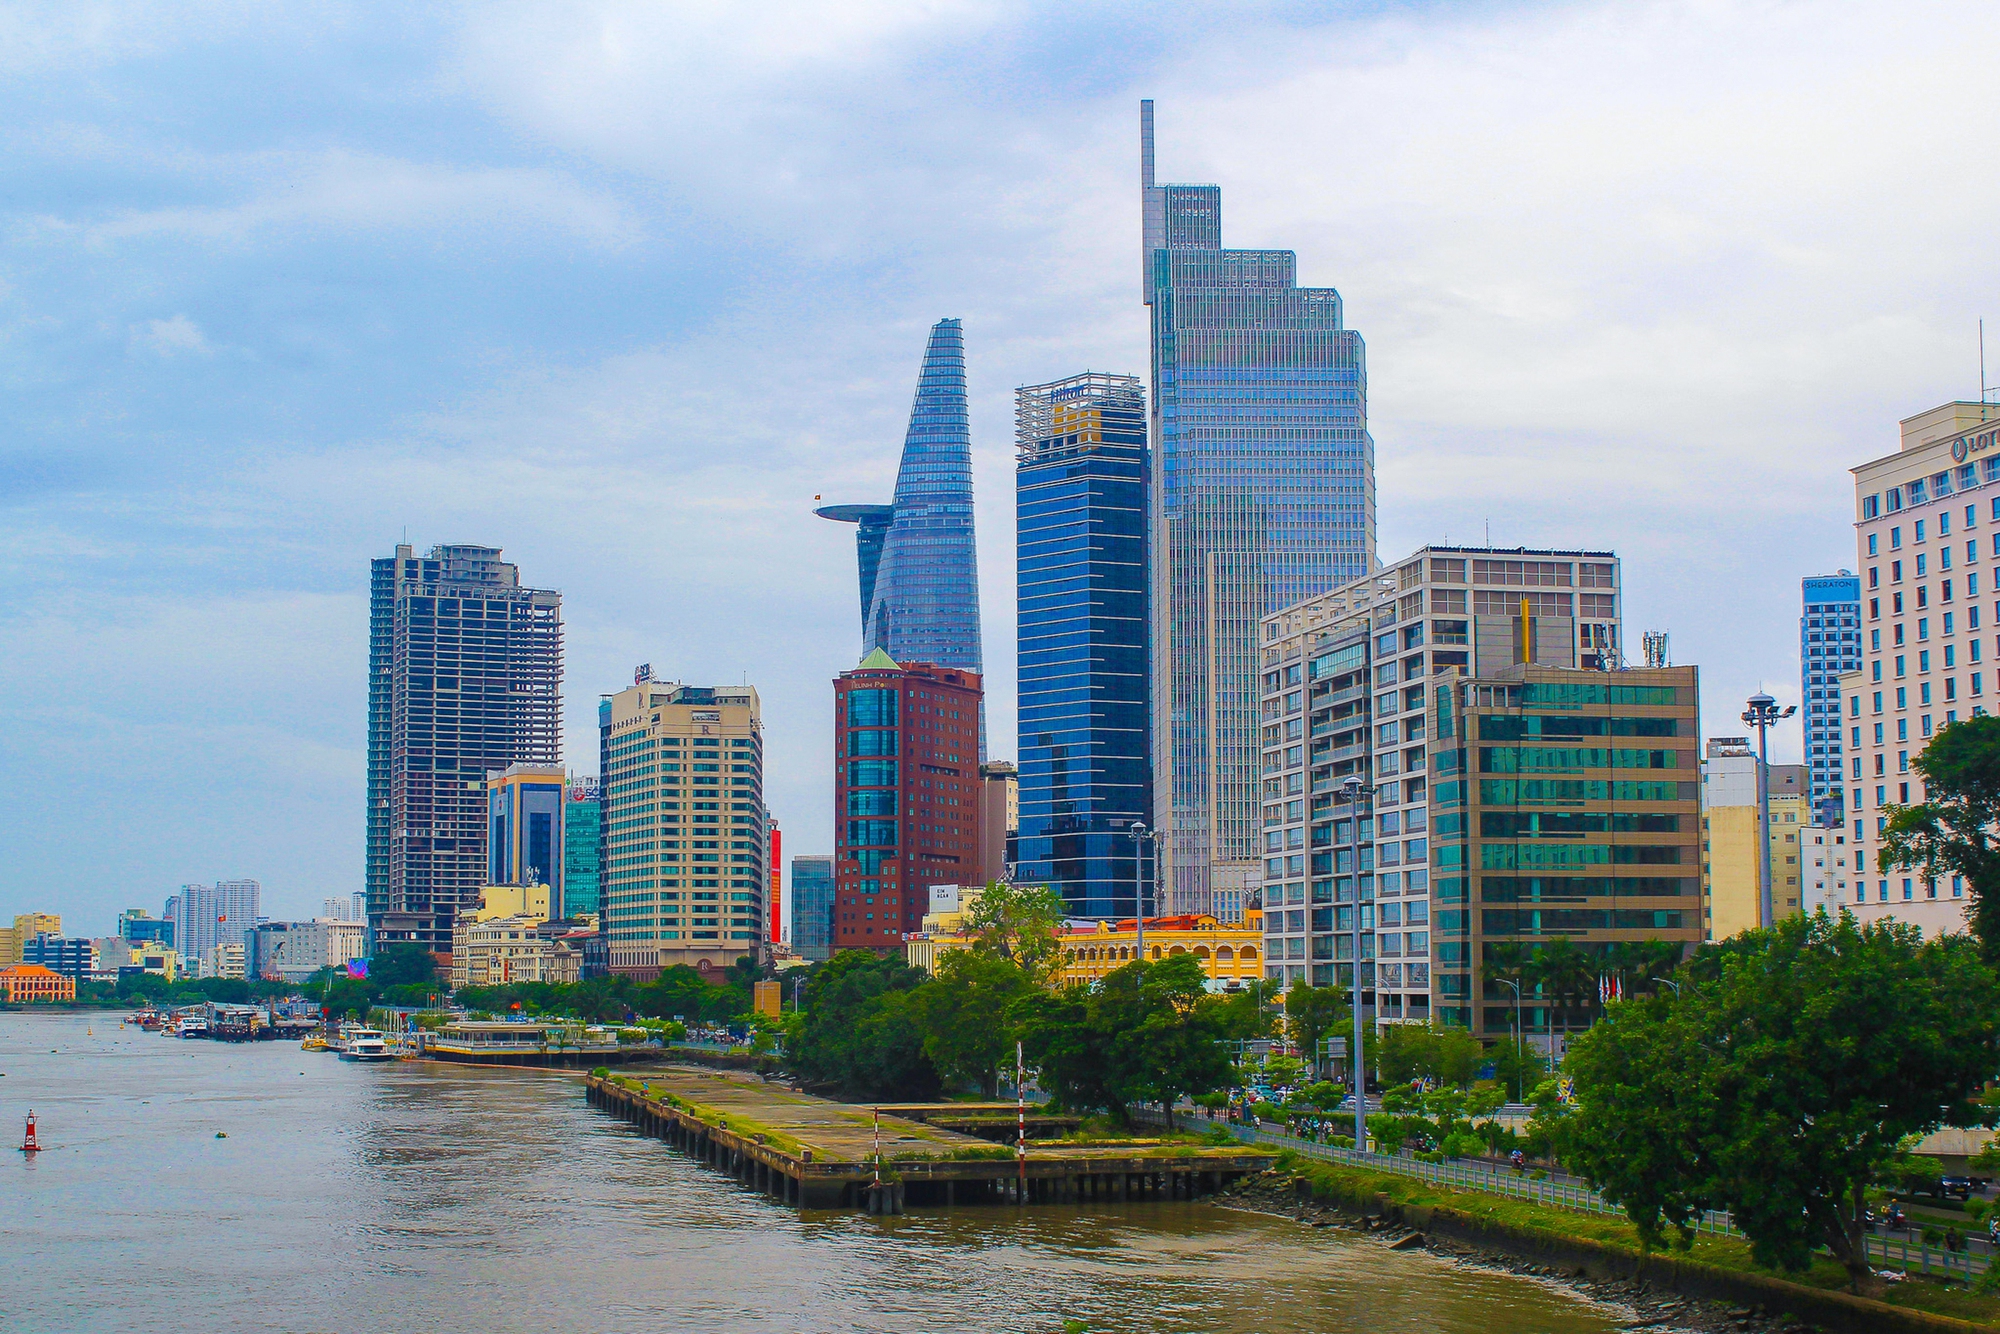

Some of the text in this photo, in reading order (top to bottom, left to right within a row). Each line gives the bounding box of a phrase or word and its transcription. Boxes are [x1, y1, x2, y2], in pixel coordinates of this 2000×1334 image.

[1051, 385, 1088, 404] Hilton
[1805, 581, 1852, 589] SHERATON
[702, 724, 710, 735] R
